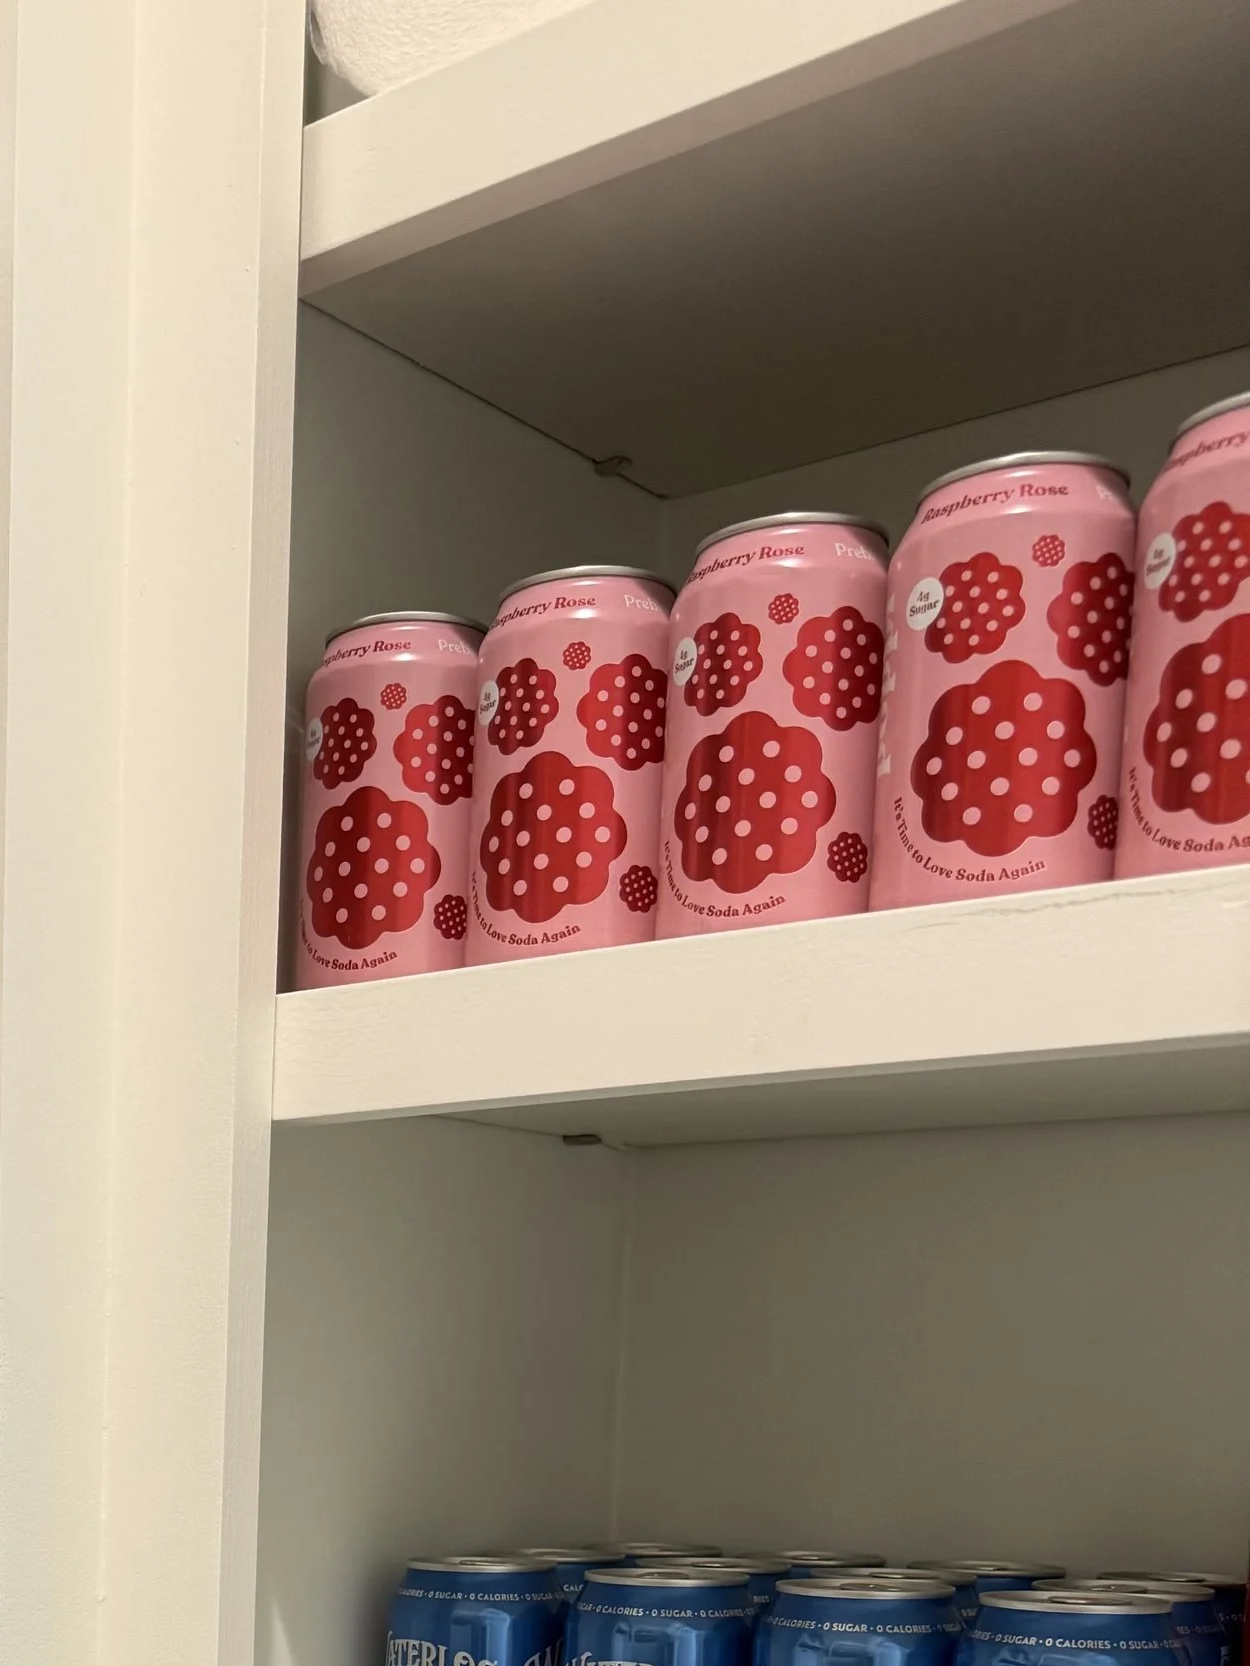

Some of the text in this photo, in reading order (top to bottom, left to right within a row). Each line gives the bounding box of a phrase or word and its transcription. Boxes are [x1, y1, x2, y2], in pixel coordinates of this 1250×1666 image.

[921, 488, 1015, 524] Raspberry
[1019, 483, 1069, 497] Rose
[758, 546, 805, 560] Rose
[834, 542, 875, 560] Preb
[917, 591, 930, 604] 4g
[492, 597, 596, 630] aspberry Rose
[909, 599, 939, 617] Sugar
[324, 640, 411, 667] spberry Rose
[1142, 820, 1224, 852] to Love Soda
[897, 819, 914, 852] Time
[911, 849, 923, 864] to
[923, 856, 953, 879] Love
[955, 868, 995, 882] Soda
[997, 859, 1046, 880] Again
[674, 888, 786, 917] to Love Soda Again
[480, 918, 581, 945] to Love Soda Again
[312, 950, 398, 970] Love Soda Again
[435, 1591, 462, 1600] SUGAR
[478, 1593, 519, 1601] CALORIES
[602, 1605, 643, 1616] CALORIES
[660, 1609, 693, 1618] SUGAR
[708, 1609, 743, 1618] CALORIES
[778, 1617, 932, 1633] CALORIES 0 SUGAR 0 CALORIES
[1002, 1634, 1037, 1646] SUGAR
[1045, 1638, 1052, 1647] 0
[1056, 1639, 1110, 1649] CALORIES
[1120, 1641, 1126, 1649] 0
[1128, 1640, 1159, 1649] SUGAR
